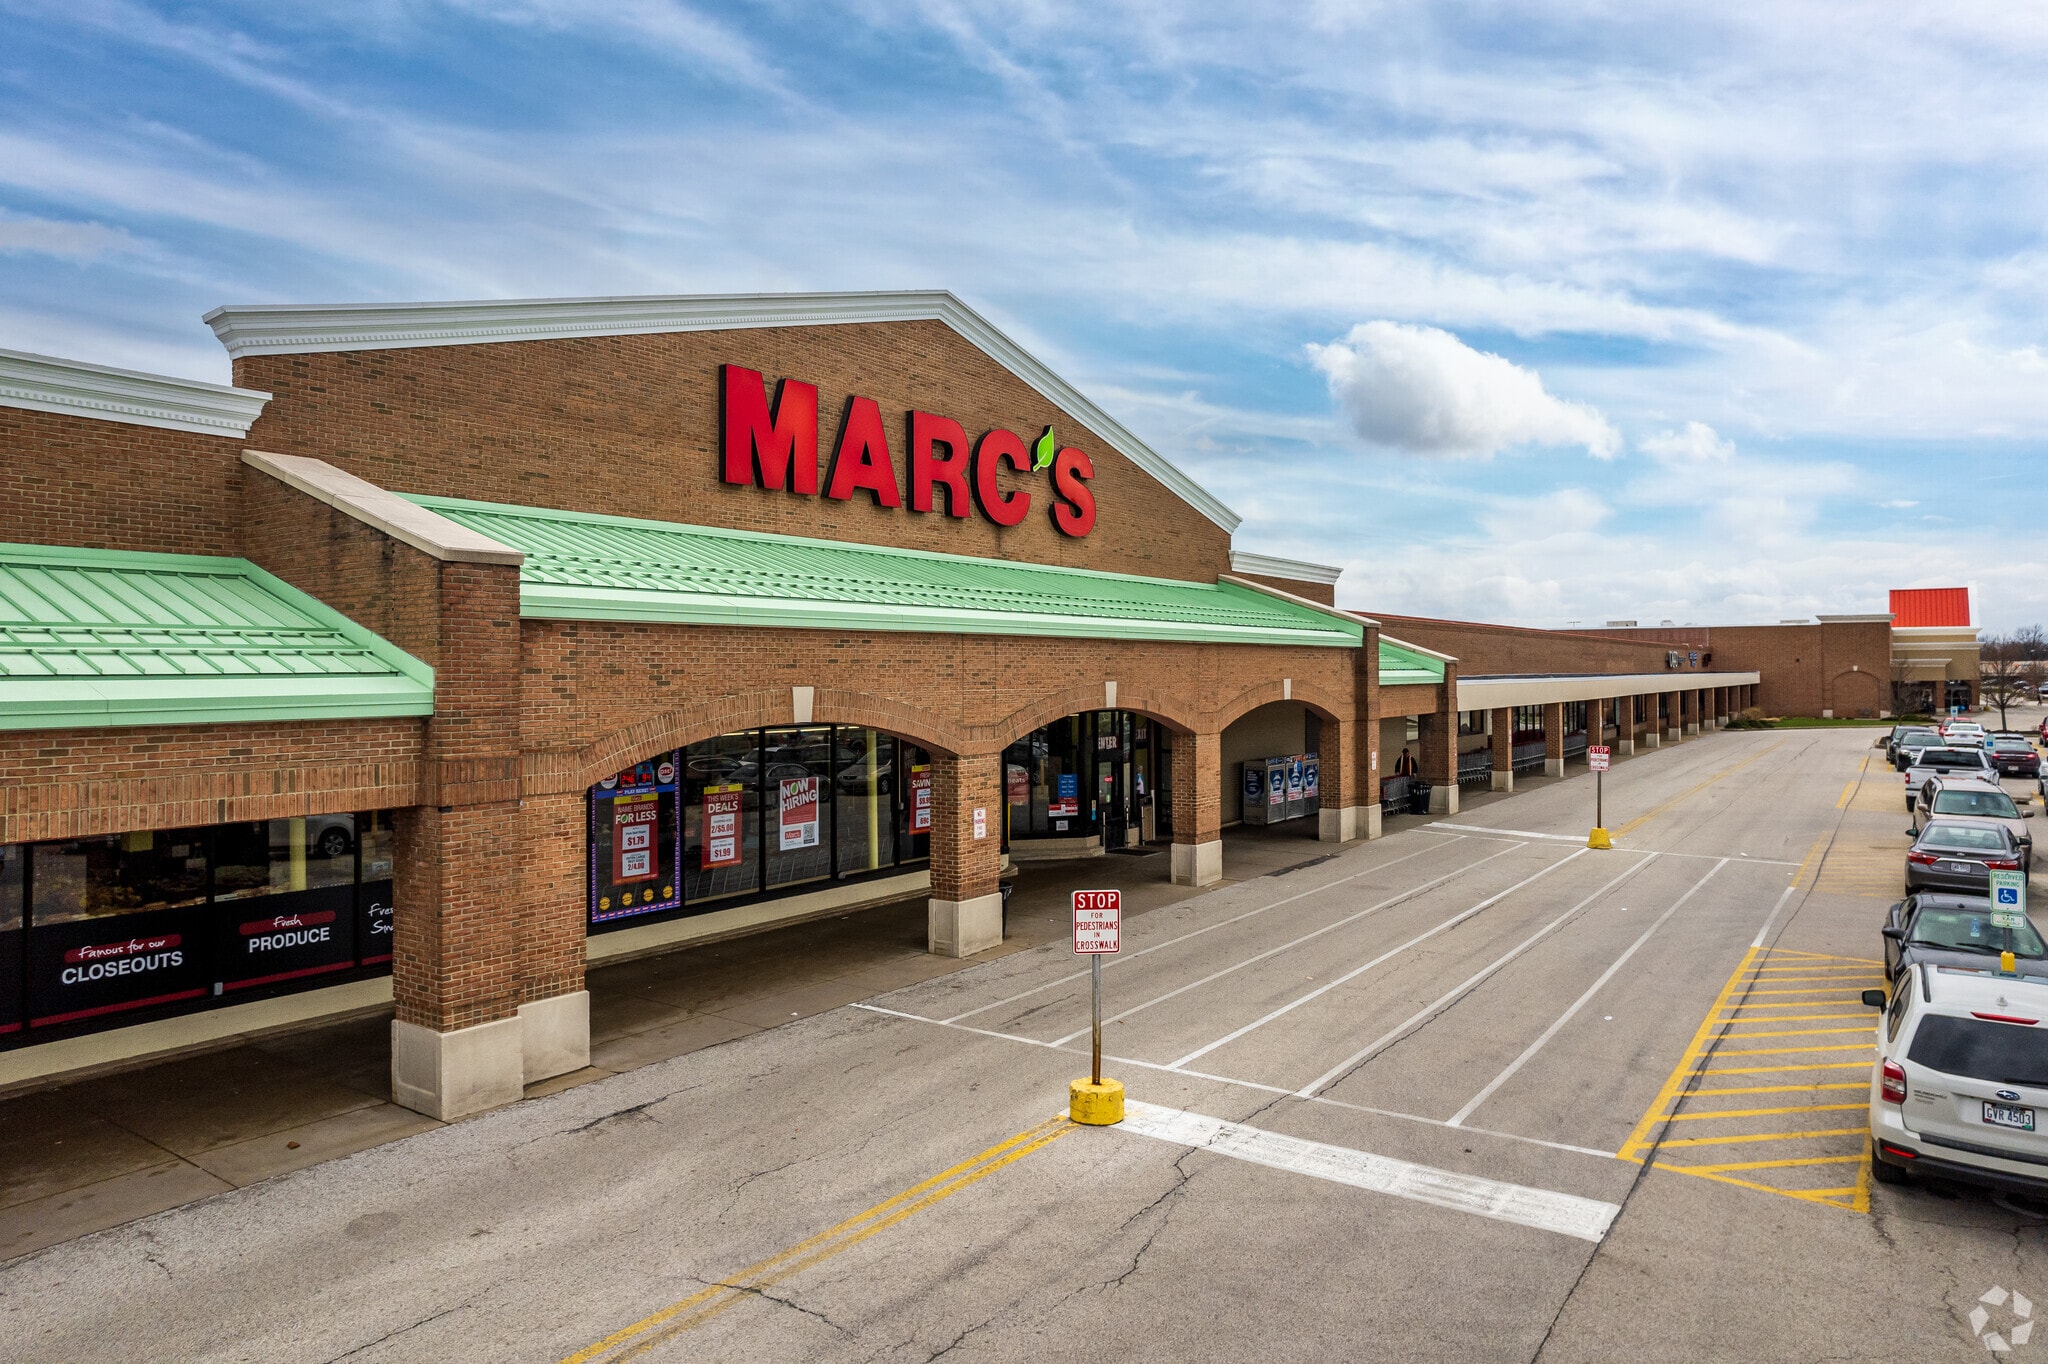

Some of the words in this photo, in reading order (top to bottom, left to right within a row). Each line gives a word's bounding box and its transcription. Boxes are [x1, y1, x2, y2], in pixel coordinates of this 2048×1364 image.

[719, 363, 1096, 537] MARC'S
[1591, 746, 1609, 754] STOP
[782, 778, 809, 799] NOW
[707, 795, 719, 803] THIS
[720, 793, 739, 801] WEEK'S
[782, 789, 817, 812] HIRING
[617, 805, 632, 814] NAME
[634, 803, 654, 811] BRANDS
[708, 801, 738, 814] DEALS
[615, 813, 634, 825] FOR
[636, 810, 657, 822] LESS
[627, 836, 645, 846] $1.79
[714, 848, 731, 858] $1.99
[1993, 873, 2023, 881] RESERVED
[1077, 893, 1117, 908] STOP
[273, 914, 303, 928] Fresh
[1076, 921, 1118, 930] PEDESTRIANS
[248, 926, 330, 953] PRODUCE
[1076, 940, 1118, 950] CROSSWALK
[78, 945, 124, 959] Famous
[127, 938, 145, 955] for
[148, 940, 166, 949] our
[61, 950, 183, 985] CLOSEOUTS
[1986, 1107, 2005, 1121] GVR
[2007, 1109, 2031, 1125] 4503
